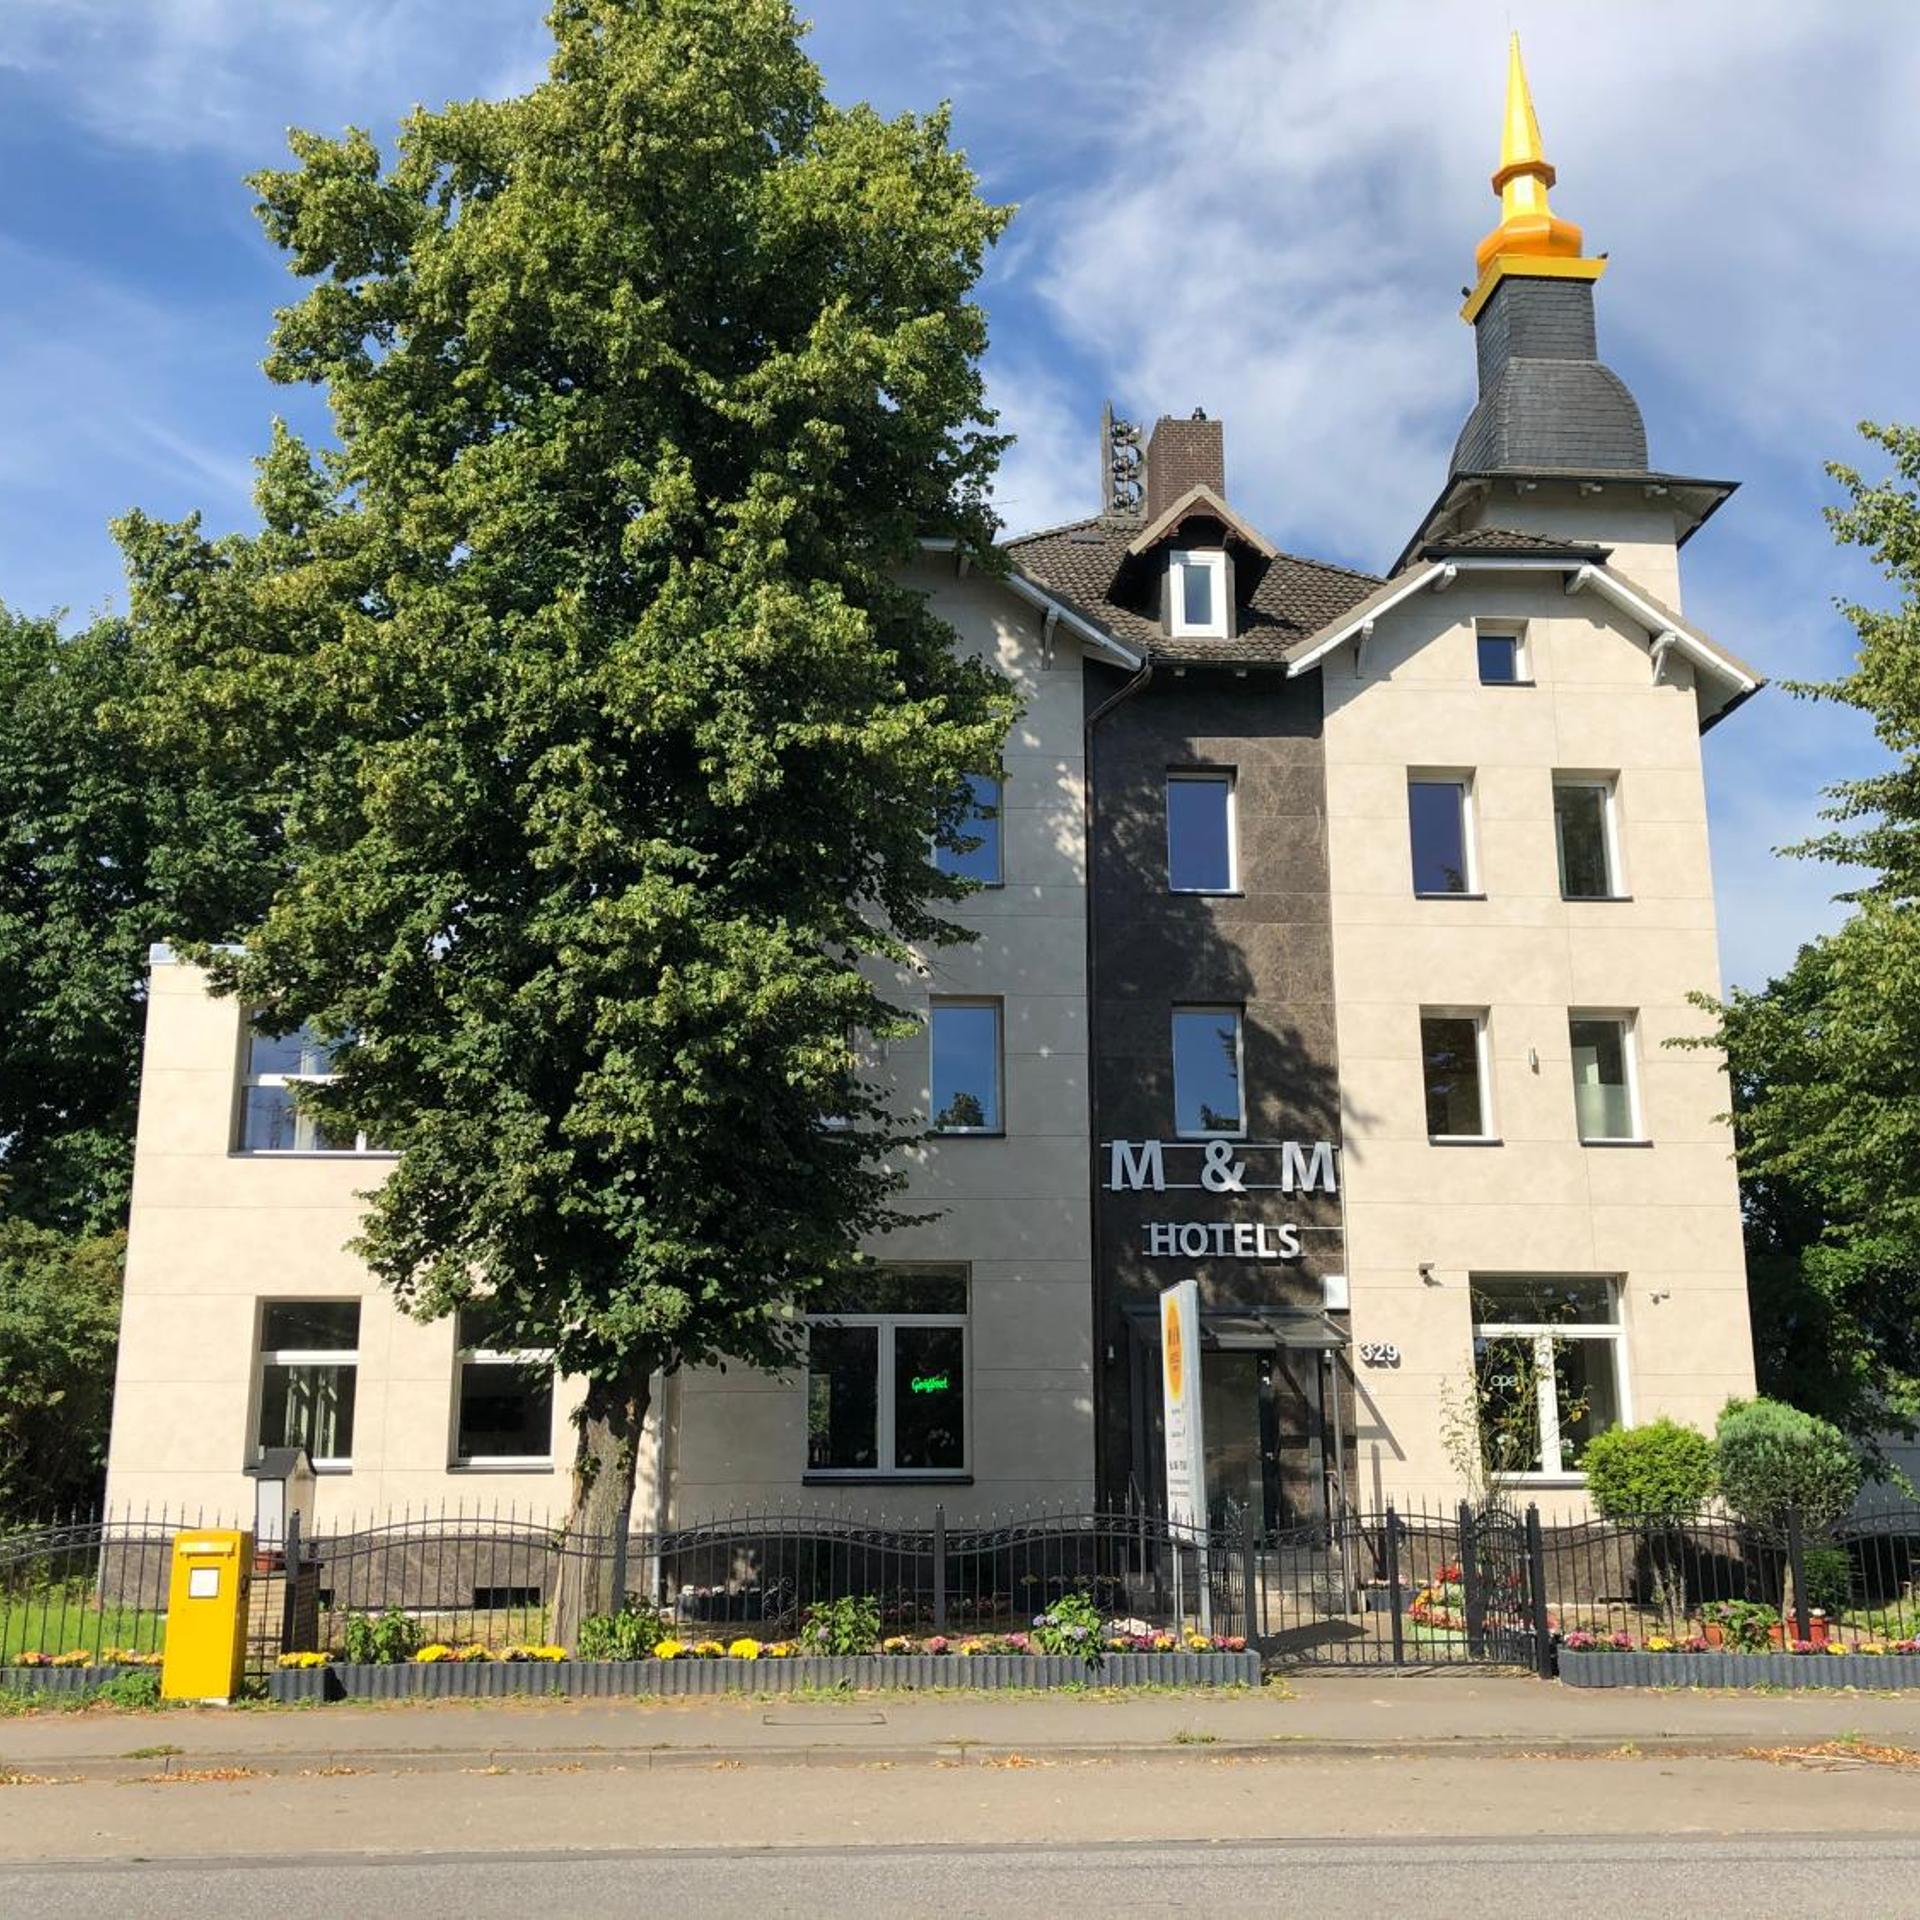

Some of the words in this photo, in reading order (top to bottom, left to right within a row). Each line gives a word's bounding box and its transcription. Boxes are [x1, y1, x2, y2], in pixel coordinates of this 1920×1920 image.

[1111, 1140, 1166, 1191] M
[1201, 1140, 1247, 1193] &
[1281, 1141, 1337, 1193] M
[1150, 1222, 1301, 1259] HOTELS
[1360, 1343, 1399, 1362] 329
[1490, 1375, 1520, 1394] ope
